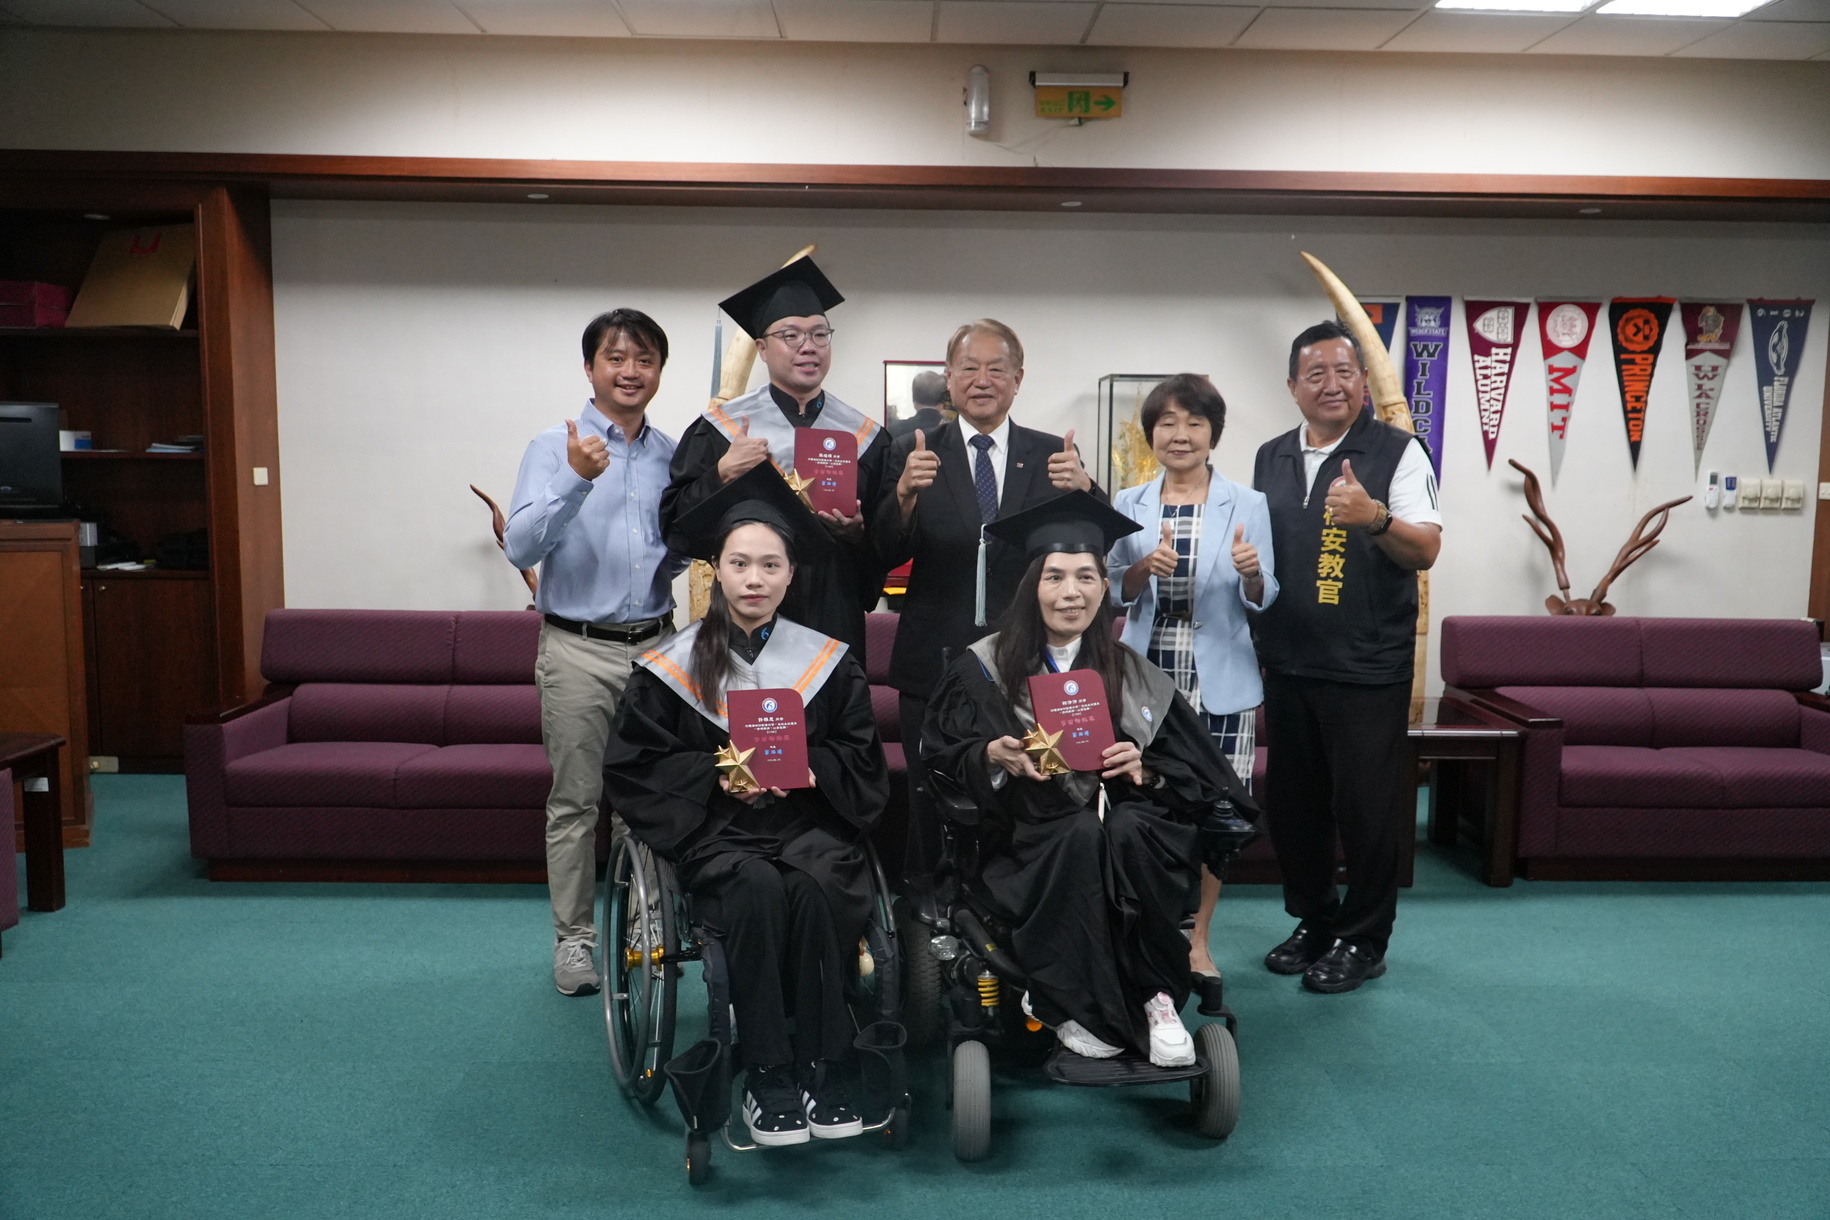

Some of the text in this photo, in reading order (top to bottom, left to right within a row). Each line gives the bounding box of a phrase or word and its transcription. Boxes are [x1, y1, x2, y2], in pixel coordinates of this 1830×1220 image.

[1474, 354, 1492, 432] ALUMNI
[1488, 347, 1512, 440] HARVARD
[1548, 364, 1578, 440] MIT
[1620, 353, 1654, 443] PRINCETON
